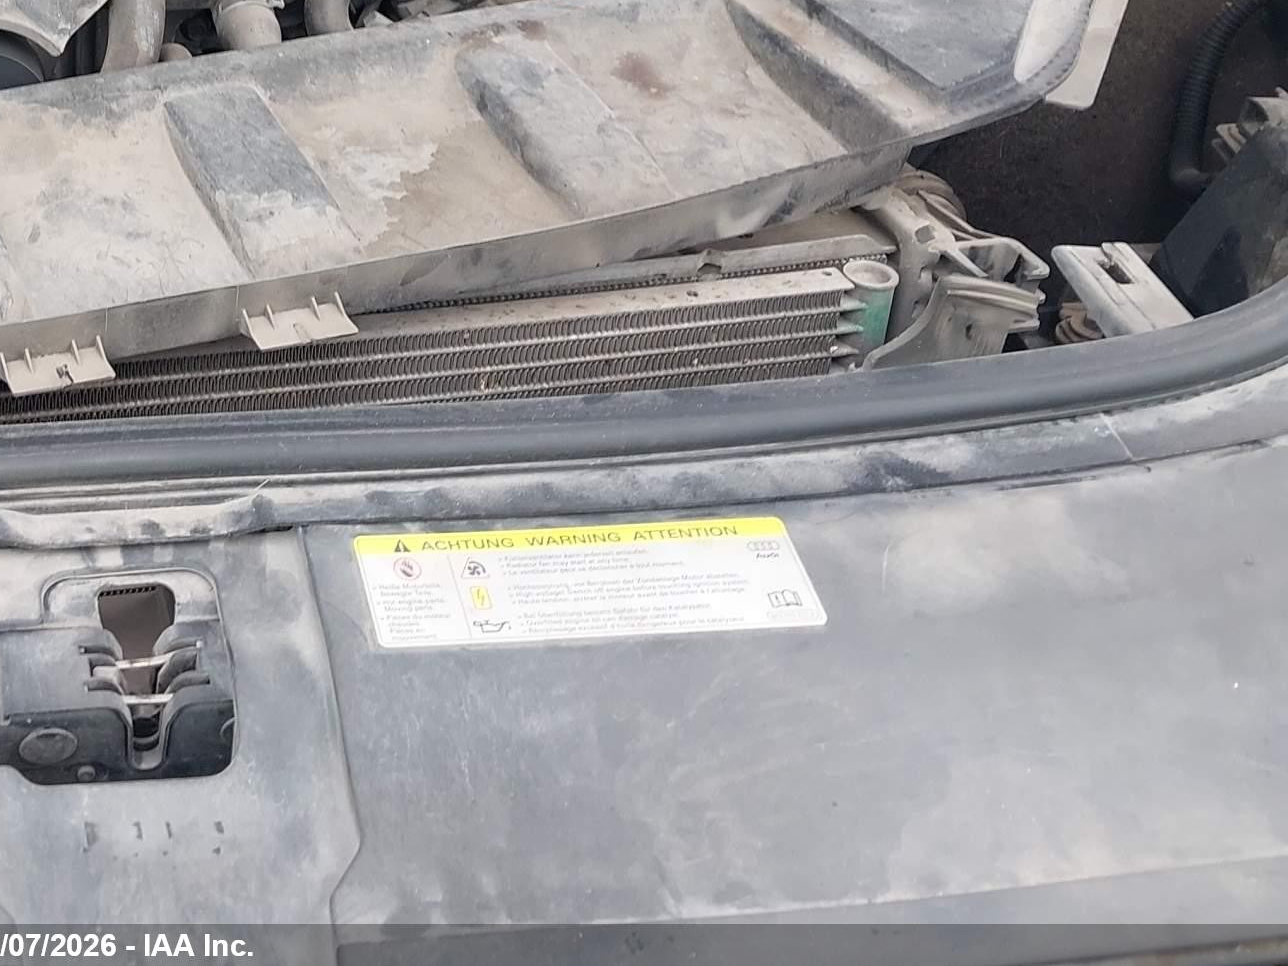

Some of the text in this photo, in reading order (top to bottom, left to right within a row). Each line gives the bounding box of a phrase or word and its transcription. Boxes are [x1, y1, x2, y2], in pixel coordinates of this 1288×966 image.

[421, 526, 739, 551] ACHTUNG WARNING ATTENTION
